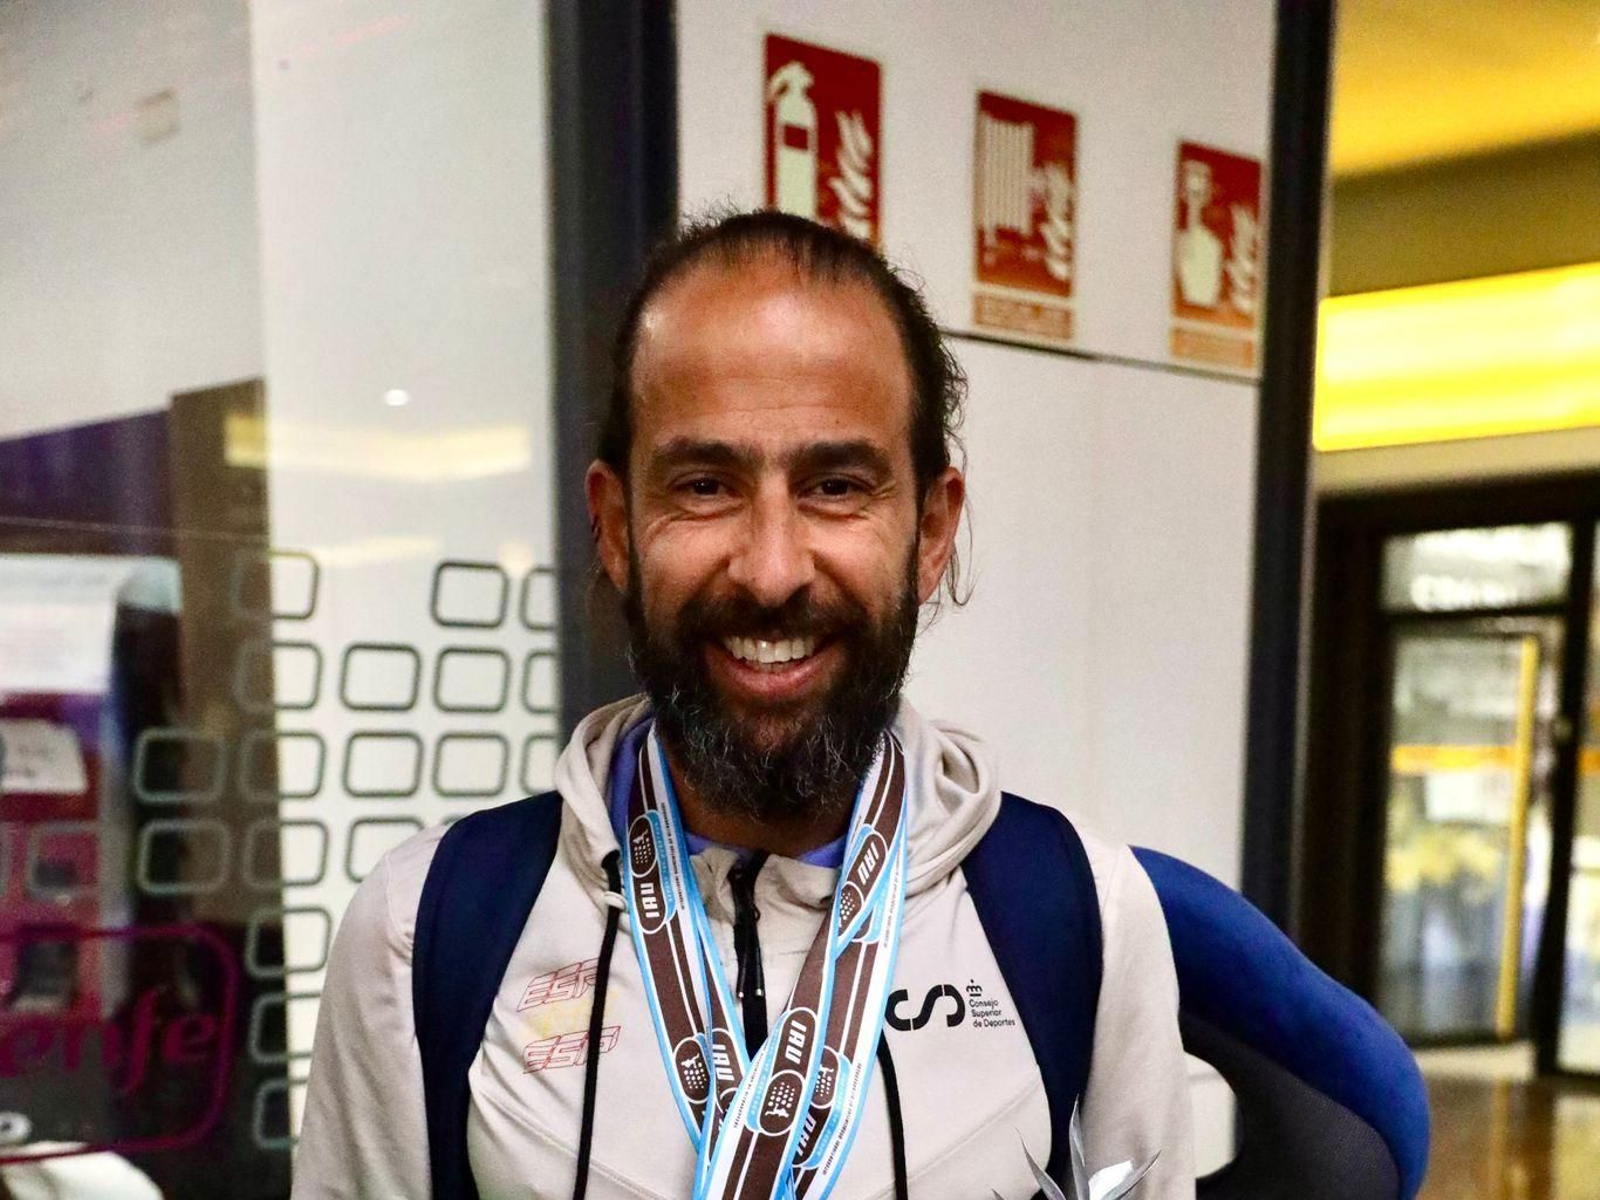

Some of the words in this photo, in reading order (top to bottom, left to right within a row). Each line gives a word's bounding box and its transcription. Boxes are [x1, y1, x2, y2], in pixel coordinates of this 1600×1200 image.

[858, 841, 879, 885] IAU
[640, 882, 660, 918] IAU
[969, 999, 999, 1009] Consejo
[972, 1009, 1002, 1018] Superior
[973, 1019, 983, 1028] de
[984, 1018, 1016, 1028] Deportes
[784, 1020, 807, 1063] IAU
